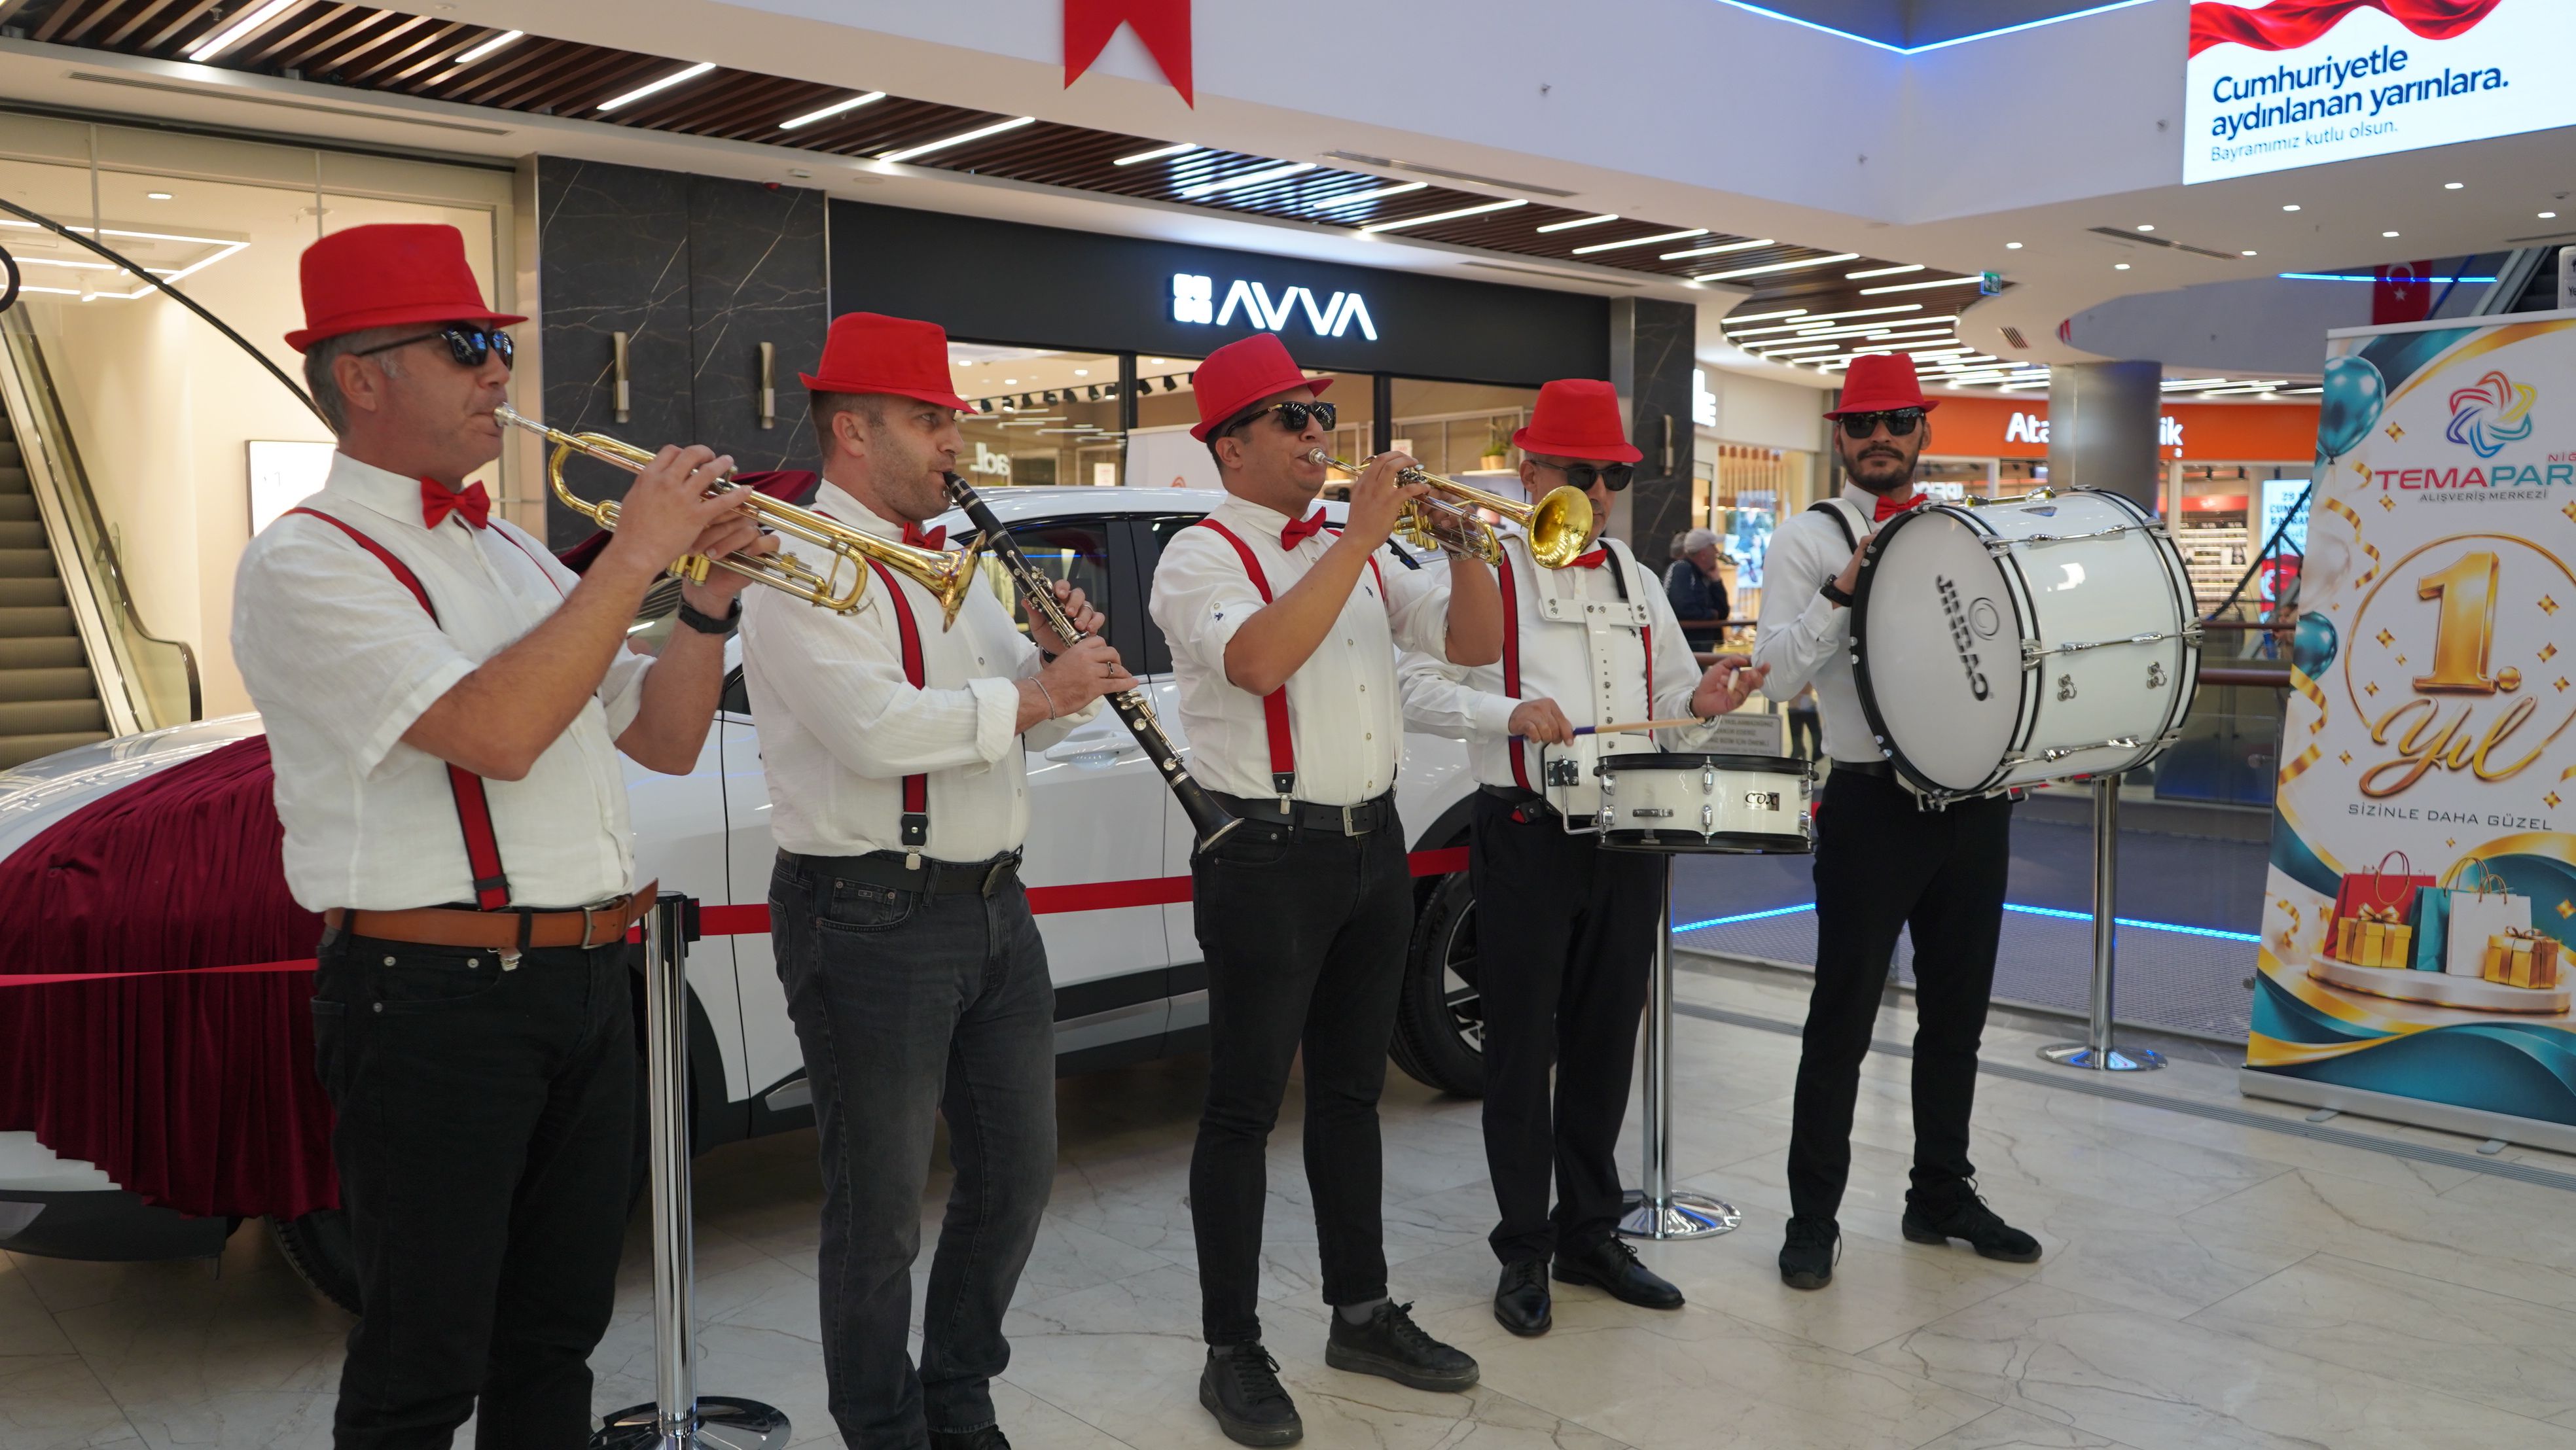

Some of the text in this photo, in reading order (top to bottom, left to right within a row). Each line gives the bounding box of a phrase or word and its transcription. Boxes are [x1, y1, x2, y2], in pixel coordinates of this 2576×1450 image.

[2213, 45, 2408, 103] Cumhuriyetle
[2212, 67, 2509, 141] aydınlanan yarınlara.
[2211, 120, 2398, 162] Bayramımız kutlu olsun.
[1216, 280, 1378, 340] AVVA
[2420, 489, 2547, 503] ALIŞVERİŞ MERKEZİ
[2348, 802, 2553, 830] SİZİNLE DAHA GÜZEL
